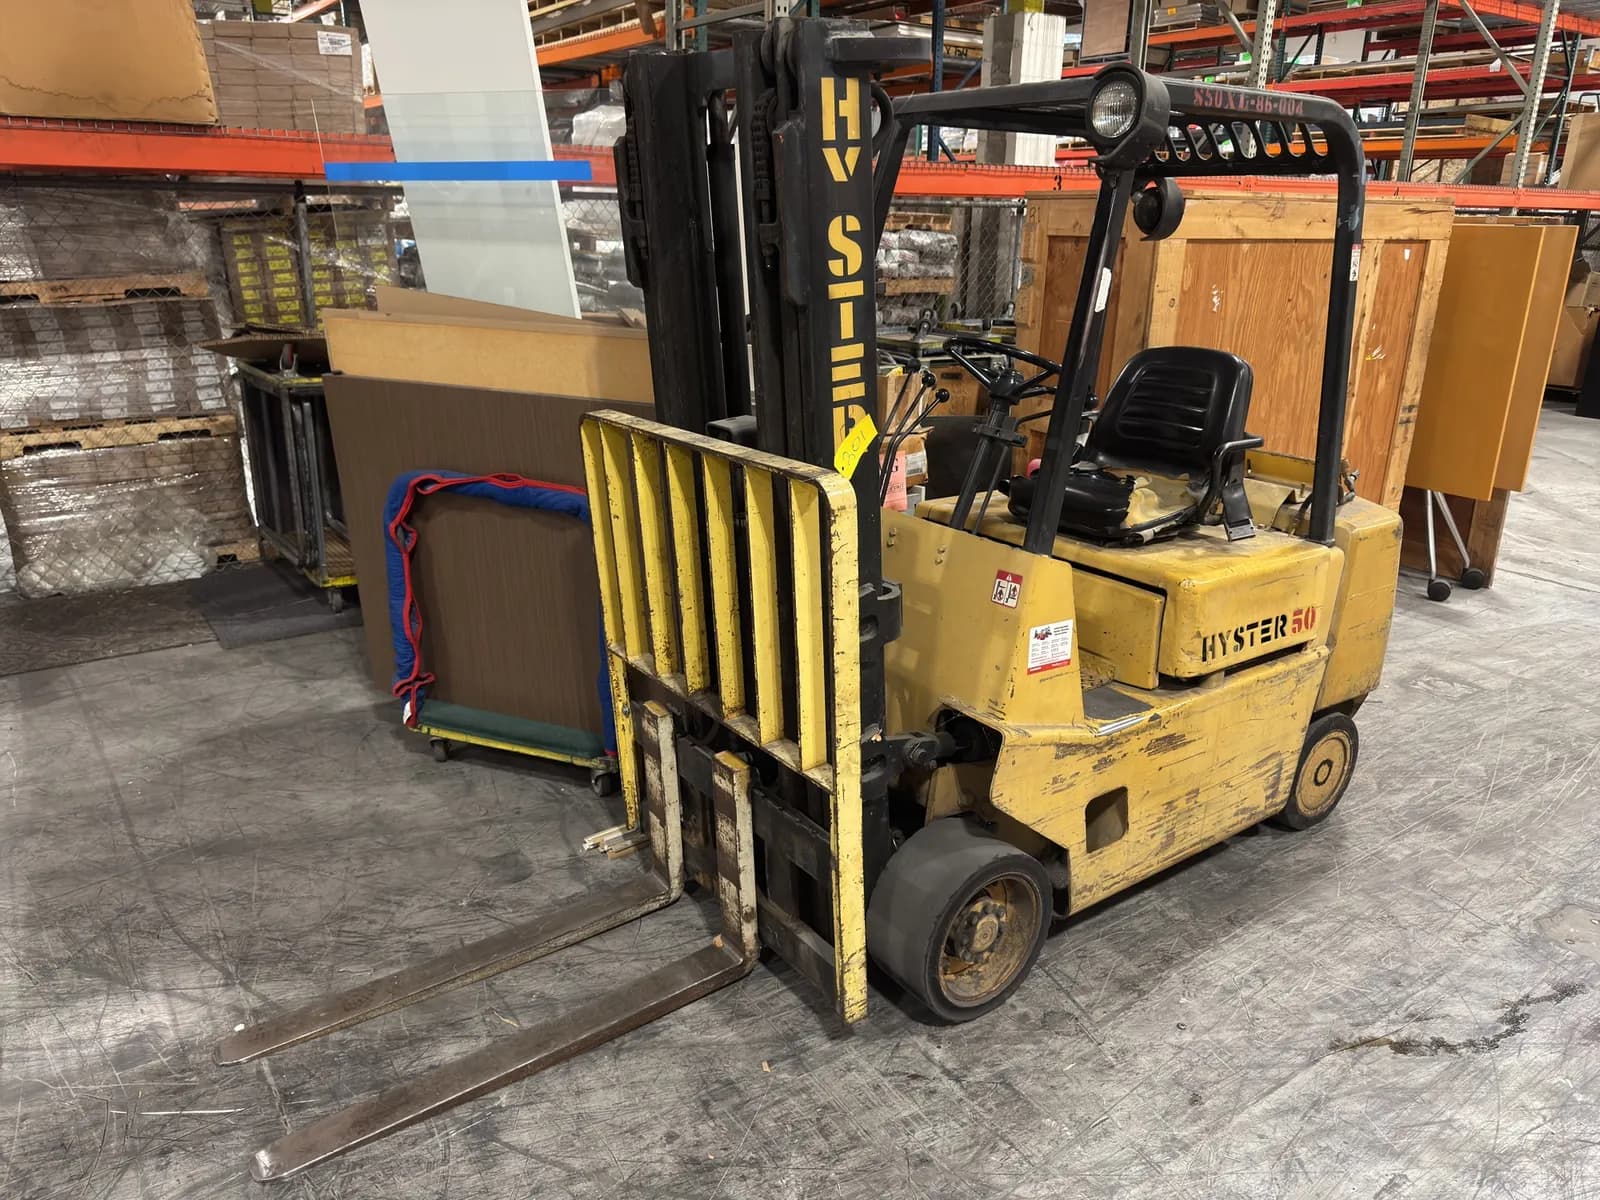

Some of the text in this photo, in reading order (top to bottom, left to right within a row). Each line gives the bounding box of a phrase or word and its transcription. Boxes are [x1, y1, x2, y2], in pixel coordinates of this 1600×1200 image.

[1053, 175, 1062, 191] 3
[1201, 605, 1317, 663] HYSTER 50
